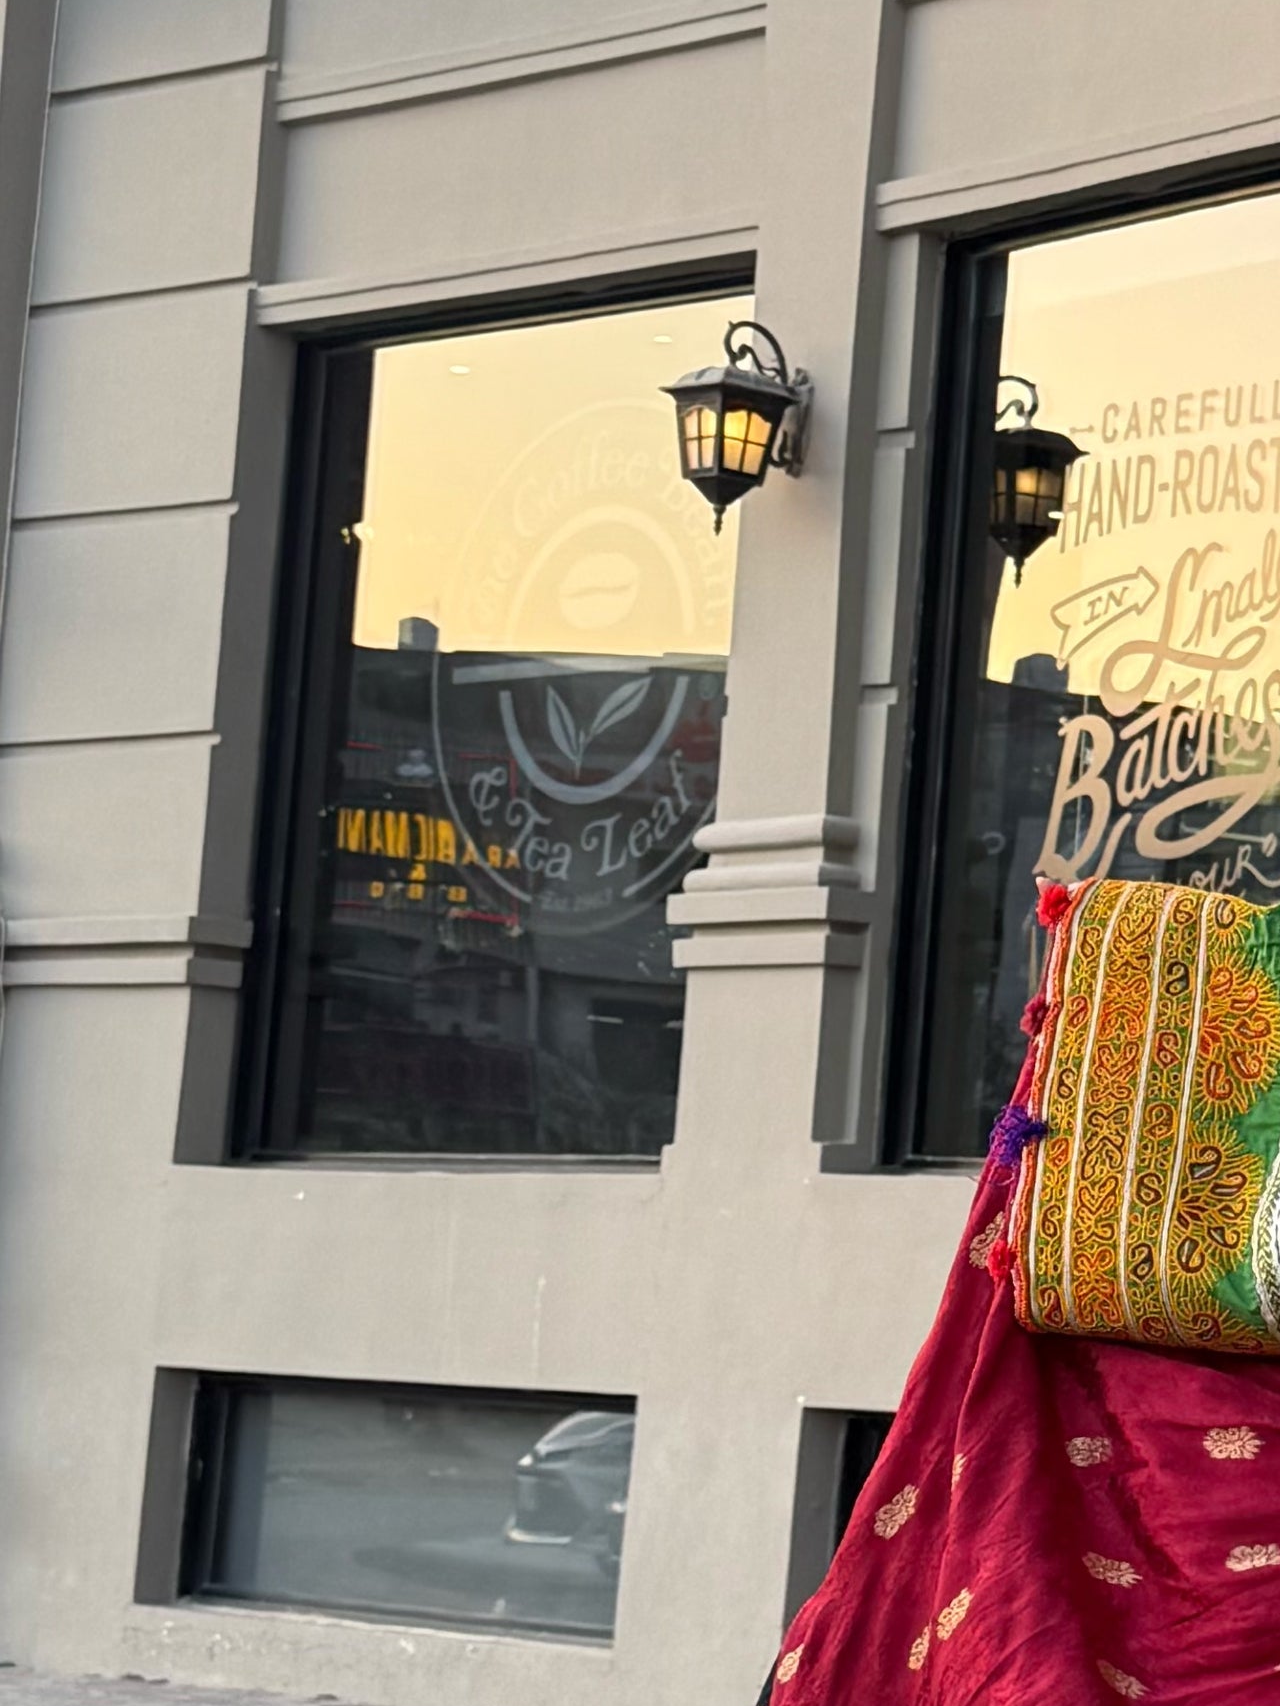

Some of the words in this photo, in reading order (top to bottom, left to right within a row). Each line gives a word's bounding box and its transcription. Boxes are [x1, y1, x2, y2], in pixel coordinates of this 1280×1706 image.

[1083, 585, 1130, 626] IN
[503, 797, 574, 882] Tea
[580, 747, 696, 877] Leaf
